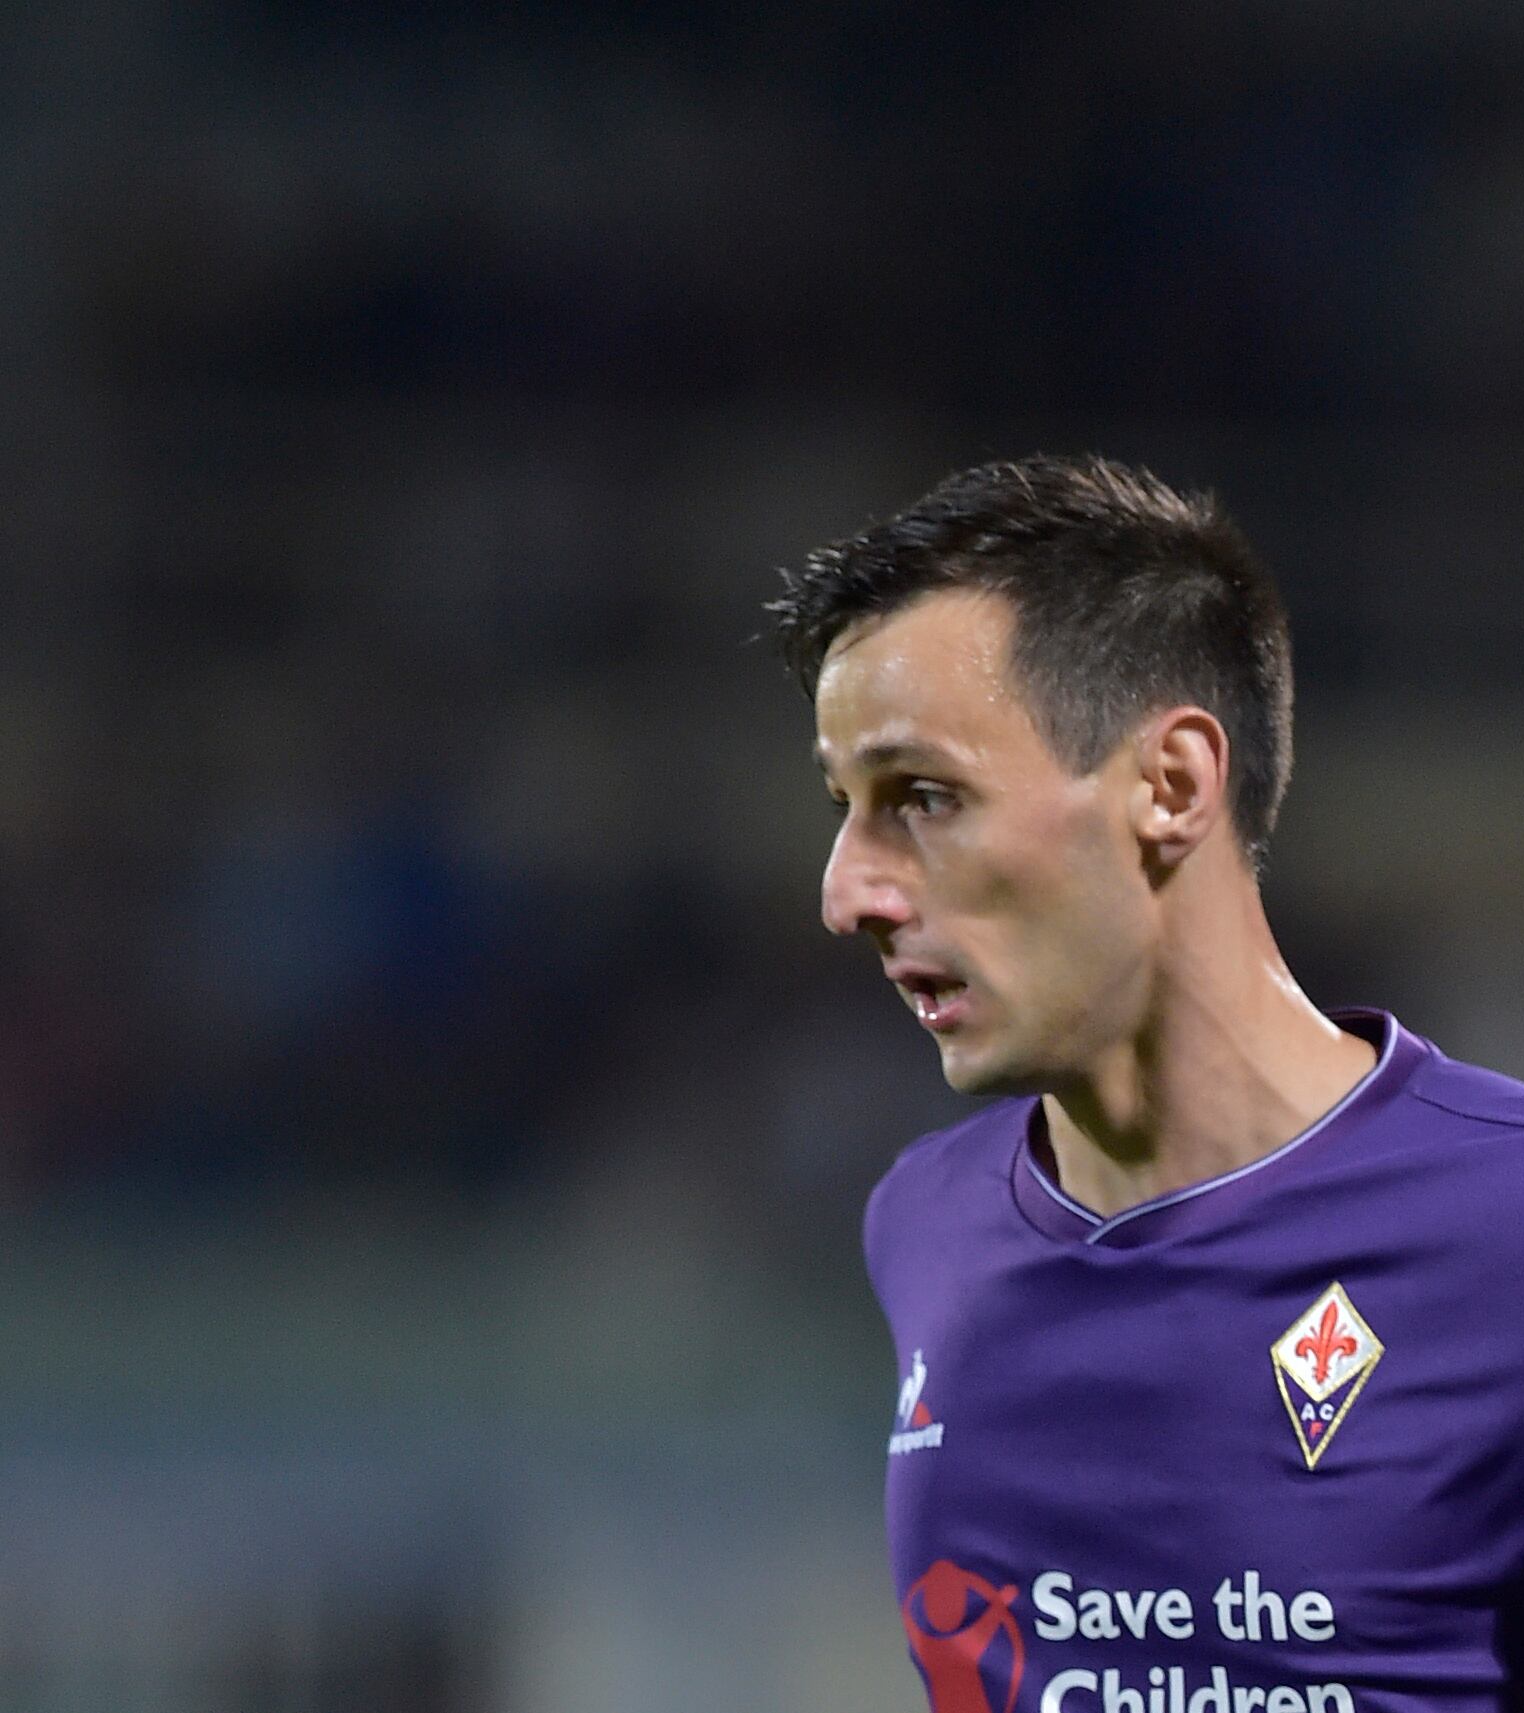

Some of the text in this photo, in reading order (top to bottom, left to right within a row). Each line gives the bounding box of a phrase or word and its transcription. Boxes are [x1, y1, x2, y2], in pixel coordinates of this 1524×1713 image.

[1310, 1421, 1325, 1438] F
[1032, 1570, 1335, 1641] Save the
[1040, 1666, 1355, 1713] Children
